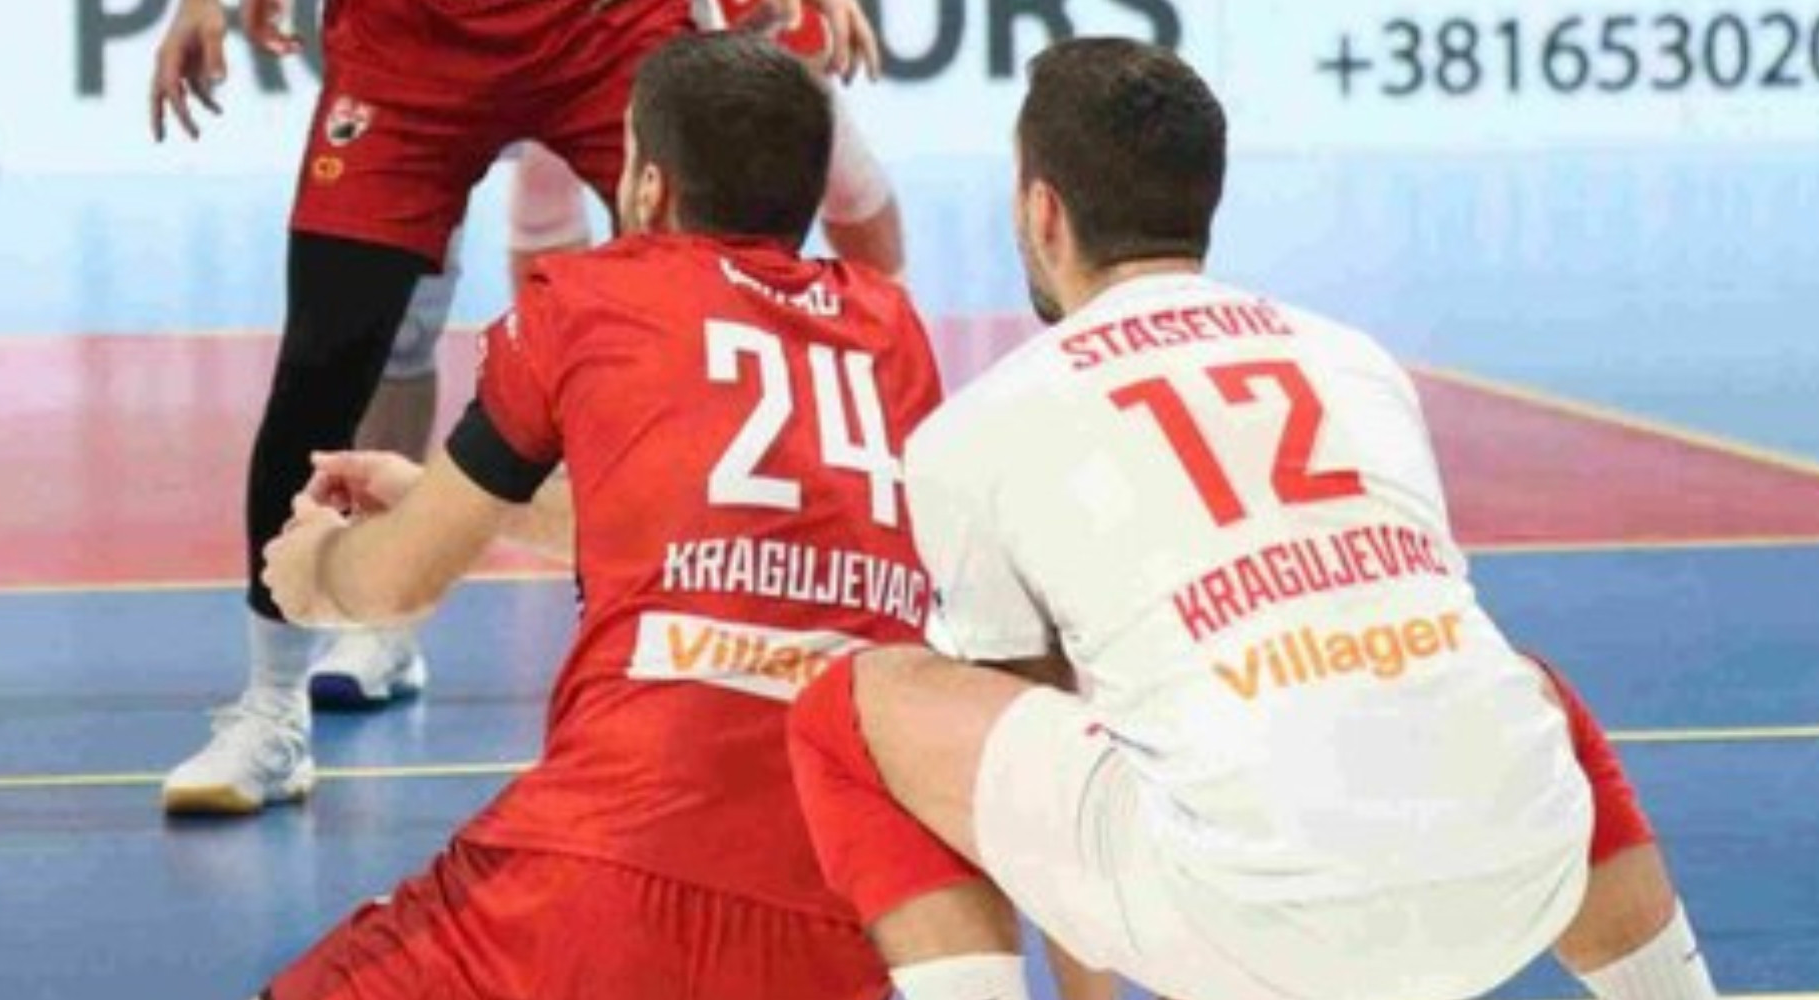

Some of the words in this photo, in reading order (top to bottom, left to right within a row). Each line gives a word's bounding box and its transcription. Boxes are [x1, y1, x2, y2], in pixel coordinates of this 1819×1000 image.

[1315, 10, 1819, 98] +38165302
[704, 318, 906, 527] 24
[1108, 359, 1368, 528] 12
[662, 537, 927, 627] KRAGUJEVAC
[1173, 523, 1451, 642] KRAGUJEVAC
[1214, 611, 1464, 700] Villager
